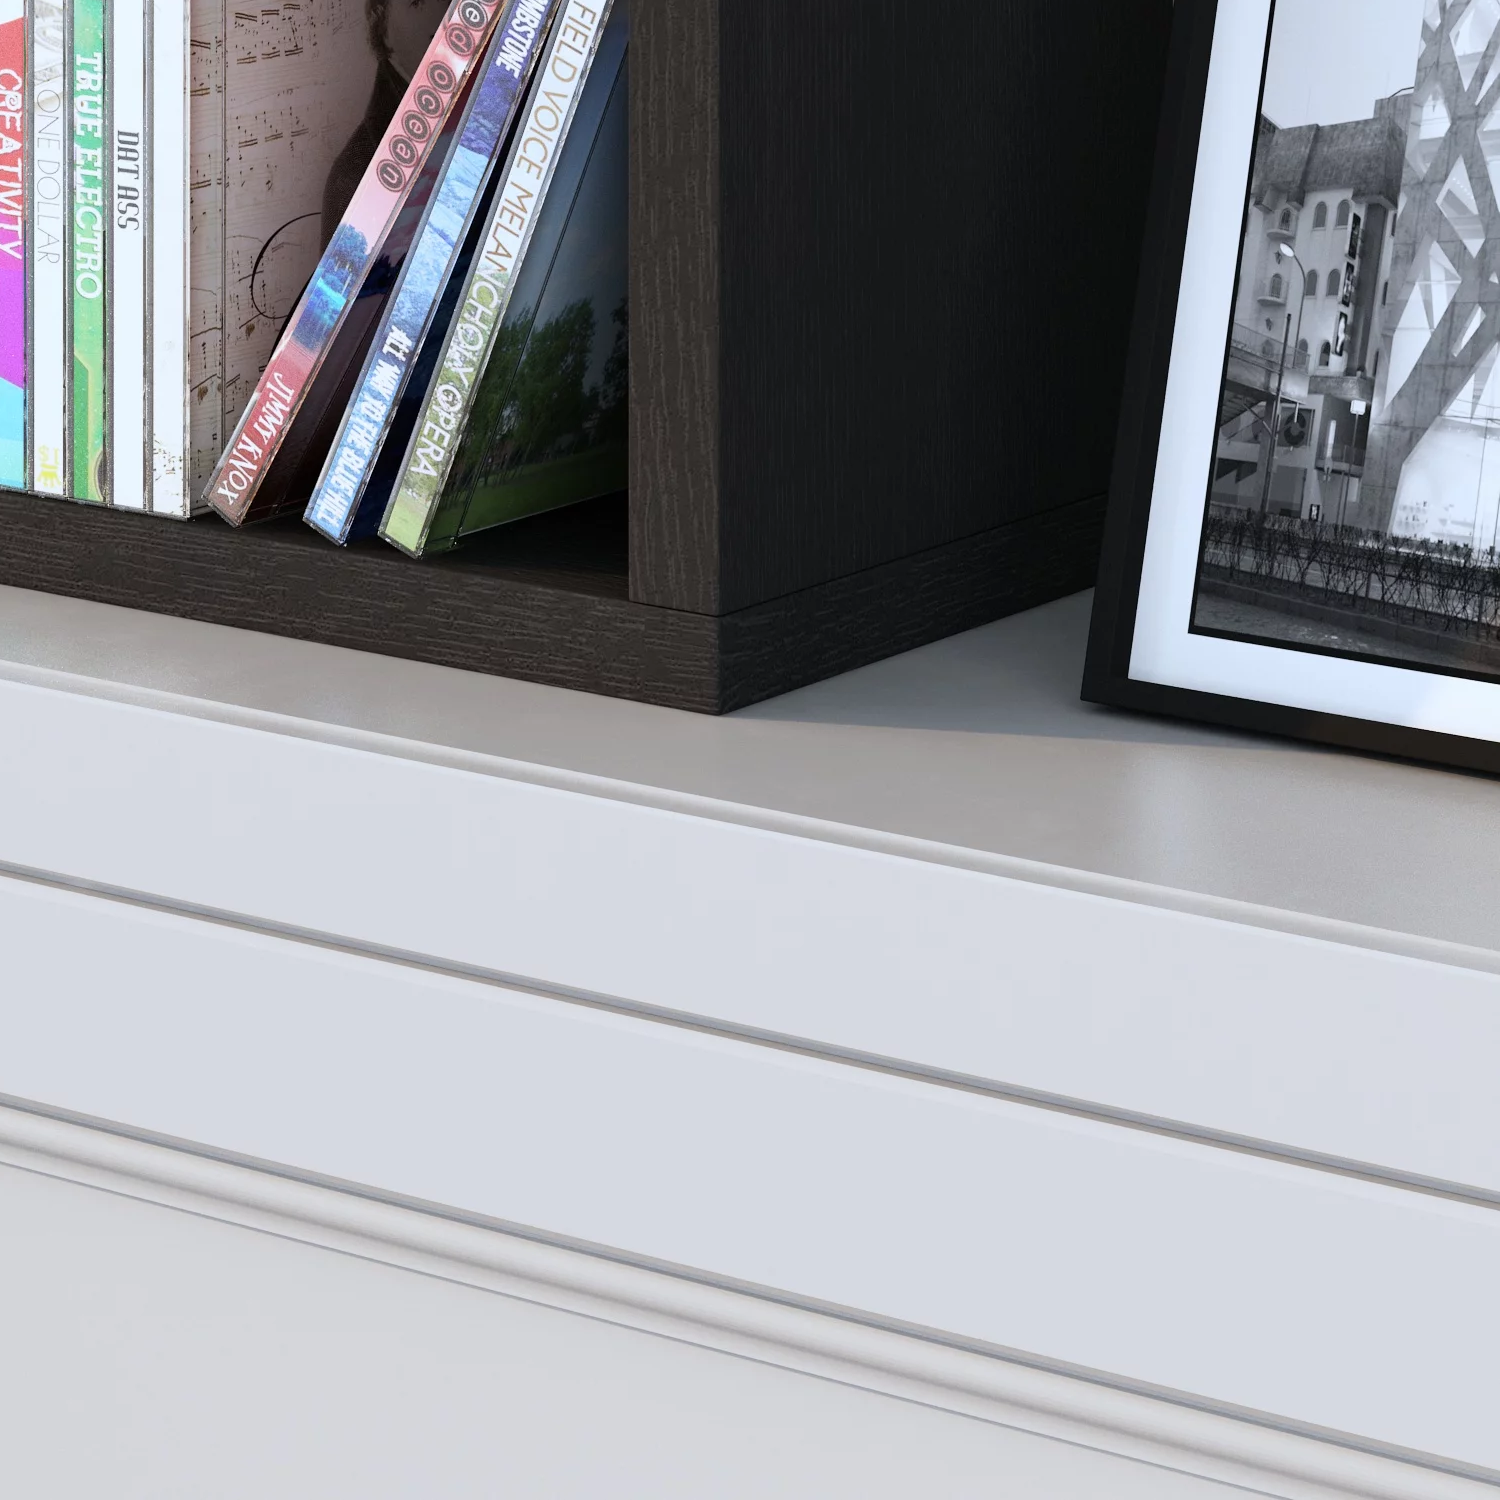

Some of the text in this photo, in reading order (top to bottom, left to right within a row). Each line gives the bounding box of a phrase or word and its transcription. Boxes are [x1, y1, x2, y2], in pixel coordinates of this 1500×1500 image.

[75, 51, 102, 299] TRUE ELECTRO
[376, 60, 457, 192] ocean
[37, 90, 60, 264] ONE DOLLAR
[117, 130, 140, 231] DAT ASS
[410, 0, 597, 478] FIELD VOICE MELANCHOLY OPERA
[369, 360, 401, 401] WAY
[382, 325, 412, 363] ALL
[217, 371, 294, 506] JIMMY KNOX
[347, 414, 378, 456] THE
[358, 391, 388, 423] TO
[331, 444, 365, 493] BLUE
